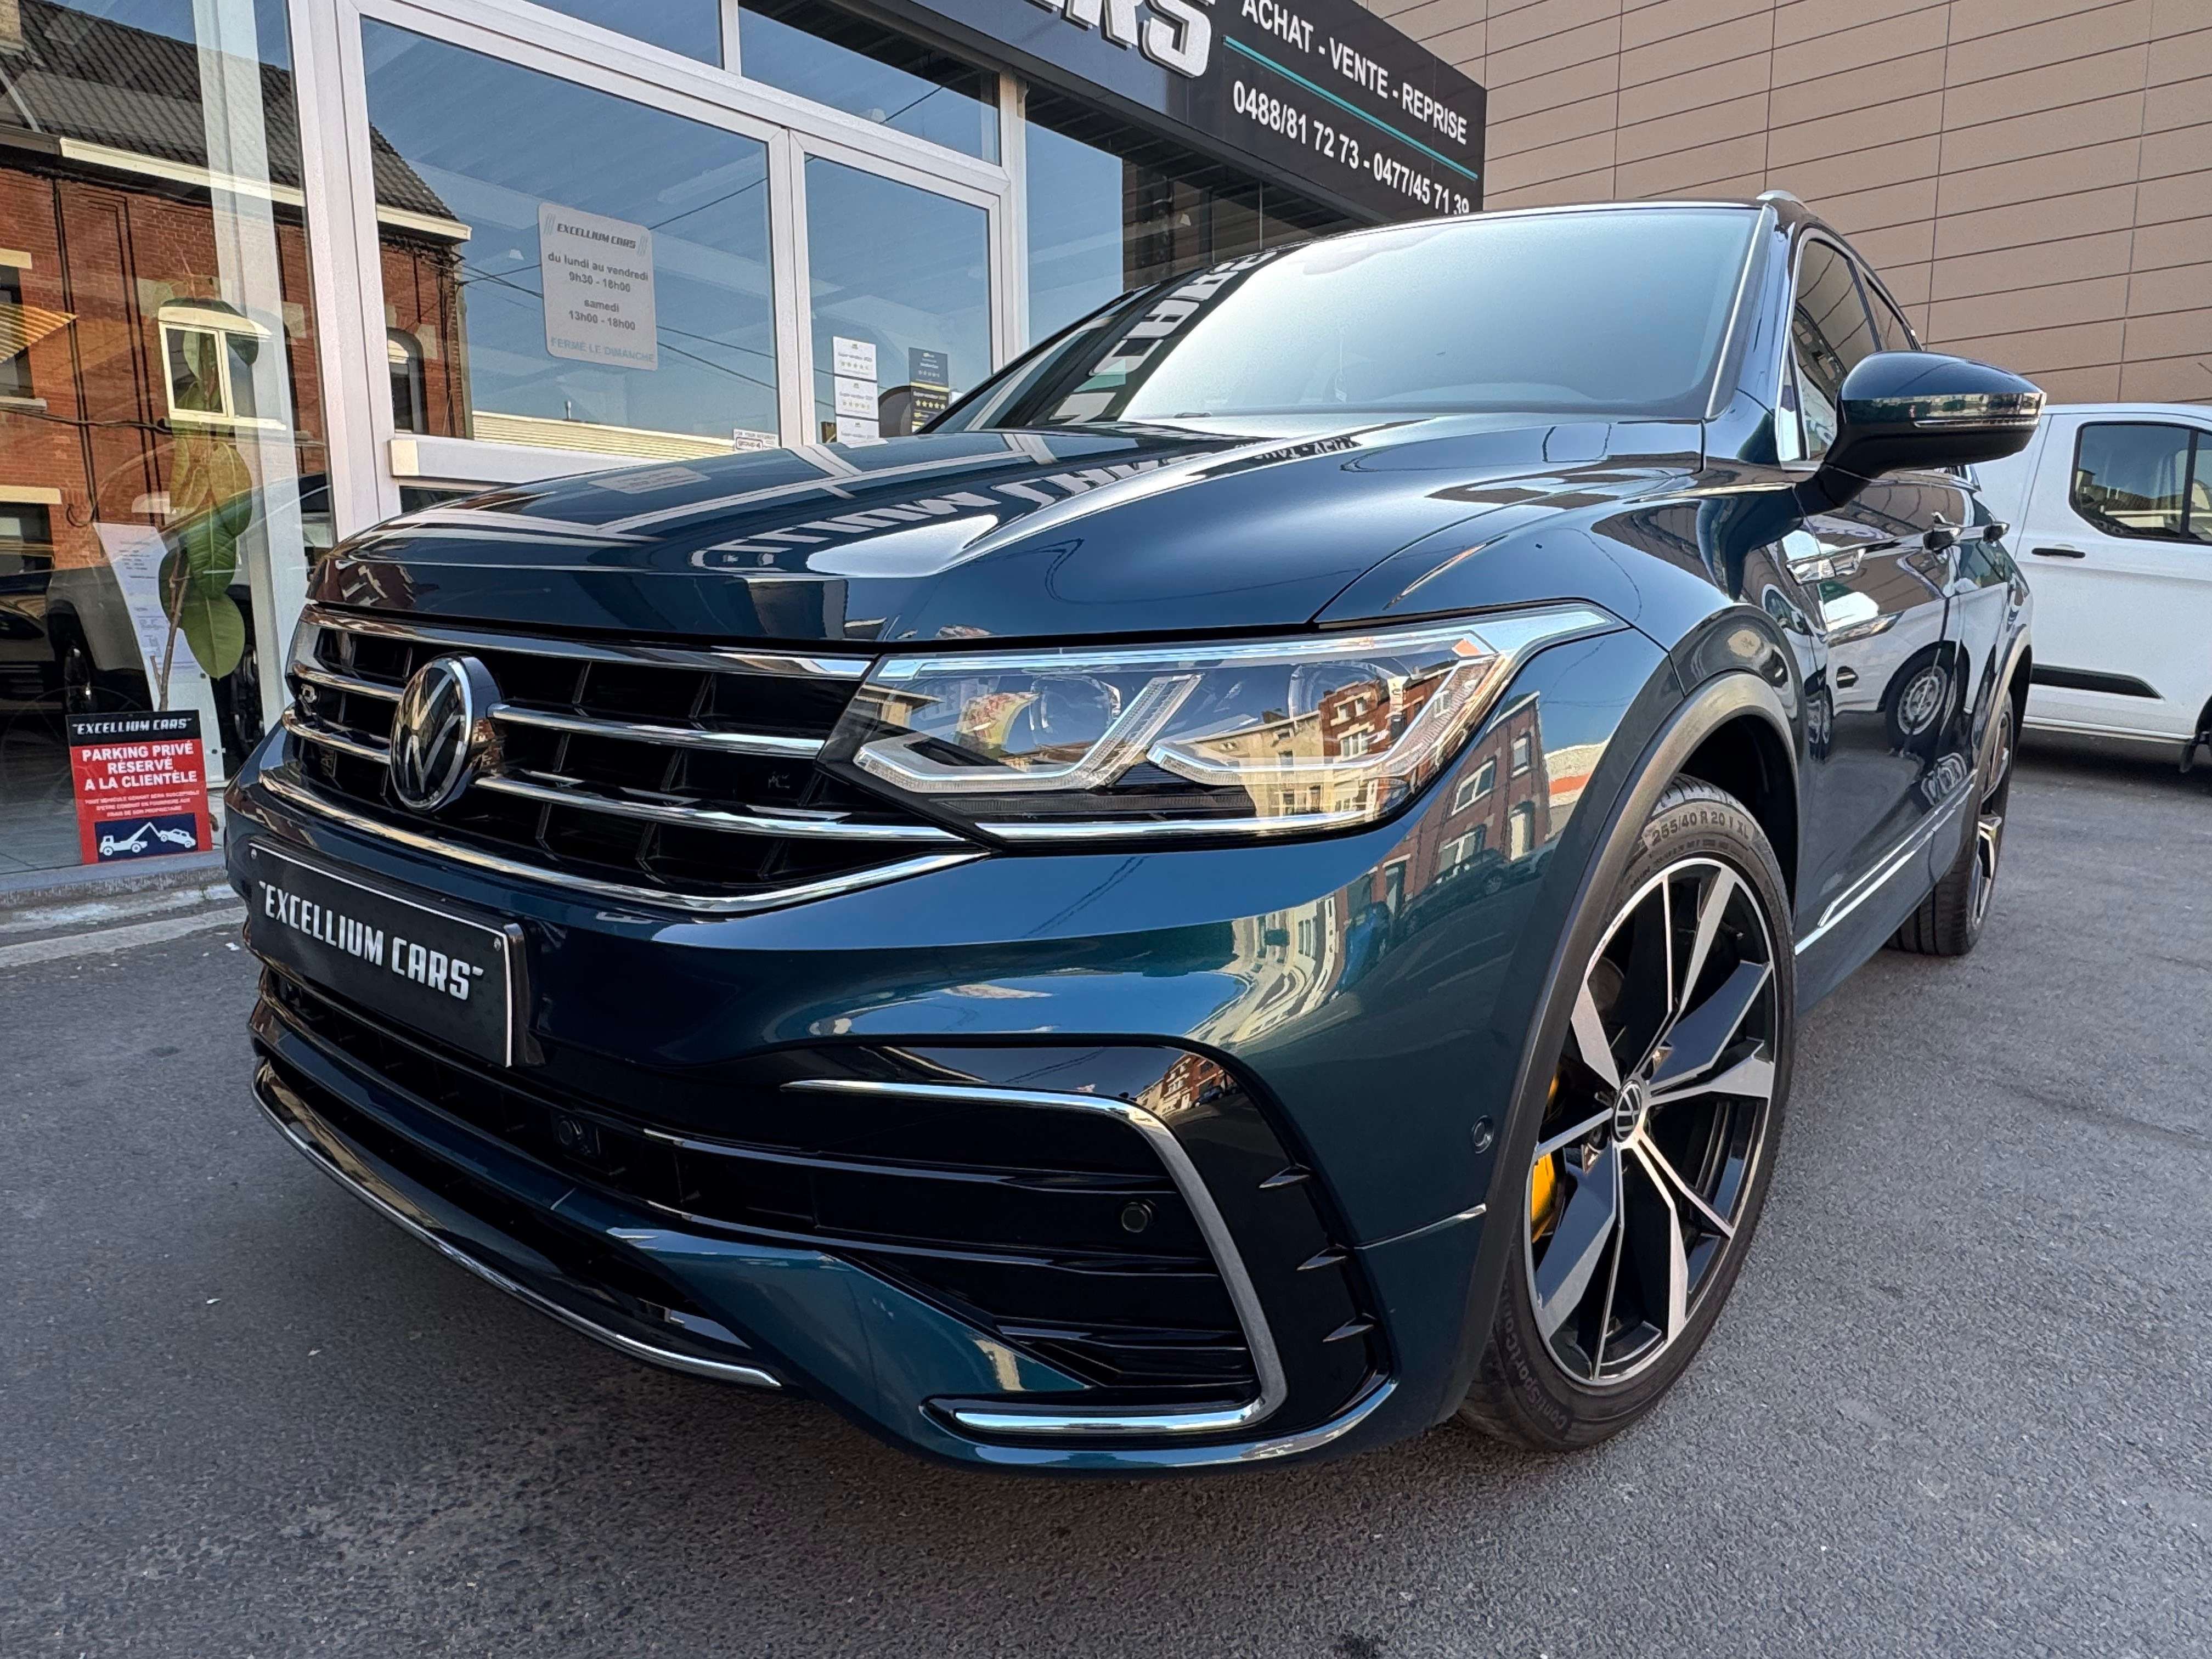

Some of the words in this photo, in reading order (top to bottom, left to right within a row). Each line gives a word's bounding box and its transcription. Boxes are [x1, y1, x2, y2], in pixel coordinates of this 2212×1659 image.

[1242, 0, 1314, 53] ACHAT
[1329, 37, 1388, 99] VENTE
[1402, 82, 1468, 145] REPRISE
[1233, 80, 1307, 145] 0488/81
[1313, 120, 1334, 158] 72
[1339, 133, 1359, 169] 73
[1373, 152, 1430, 205] 0477/45
[1434, 183, 1449, 214] 71
[557, 223, 610, 243] EXCELLIUM
[611, 236, 636, 249] CARS
[548, 252, 561, 262] du
[564, 255, 589, 269] lundi
[592, 263, 604, 272] au
[607, 266, 648, 281] vendredi
[568, 271, 593, 285] 9h30
[603, 278, 631, 292] 18h00
[584, 300, 619, 312] samedi
[569, 310, 598, 323] 13h00
[607, 317, 635, 330] 18h00
[588, 343, 602, 354] LE
[605, 346, 654, 363] DIMANCHE
[82, 746, 149, 761] PARKING
[153, 740, 194, 757] PRIVÉ
[108, 756, 173, 774] RÉSERVÉ
[99, 777, 119, 789] LA
[1711, 811, 1725, 826] 20
